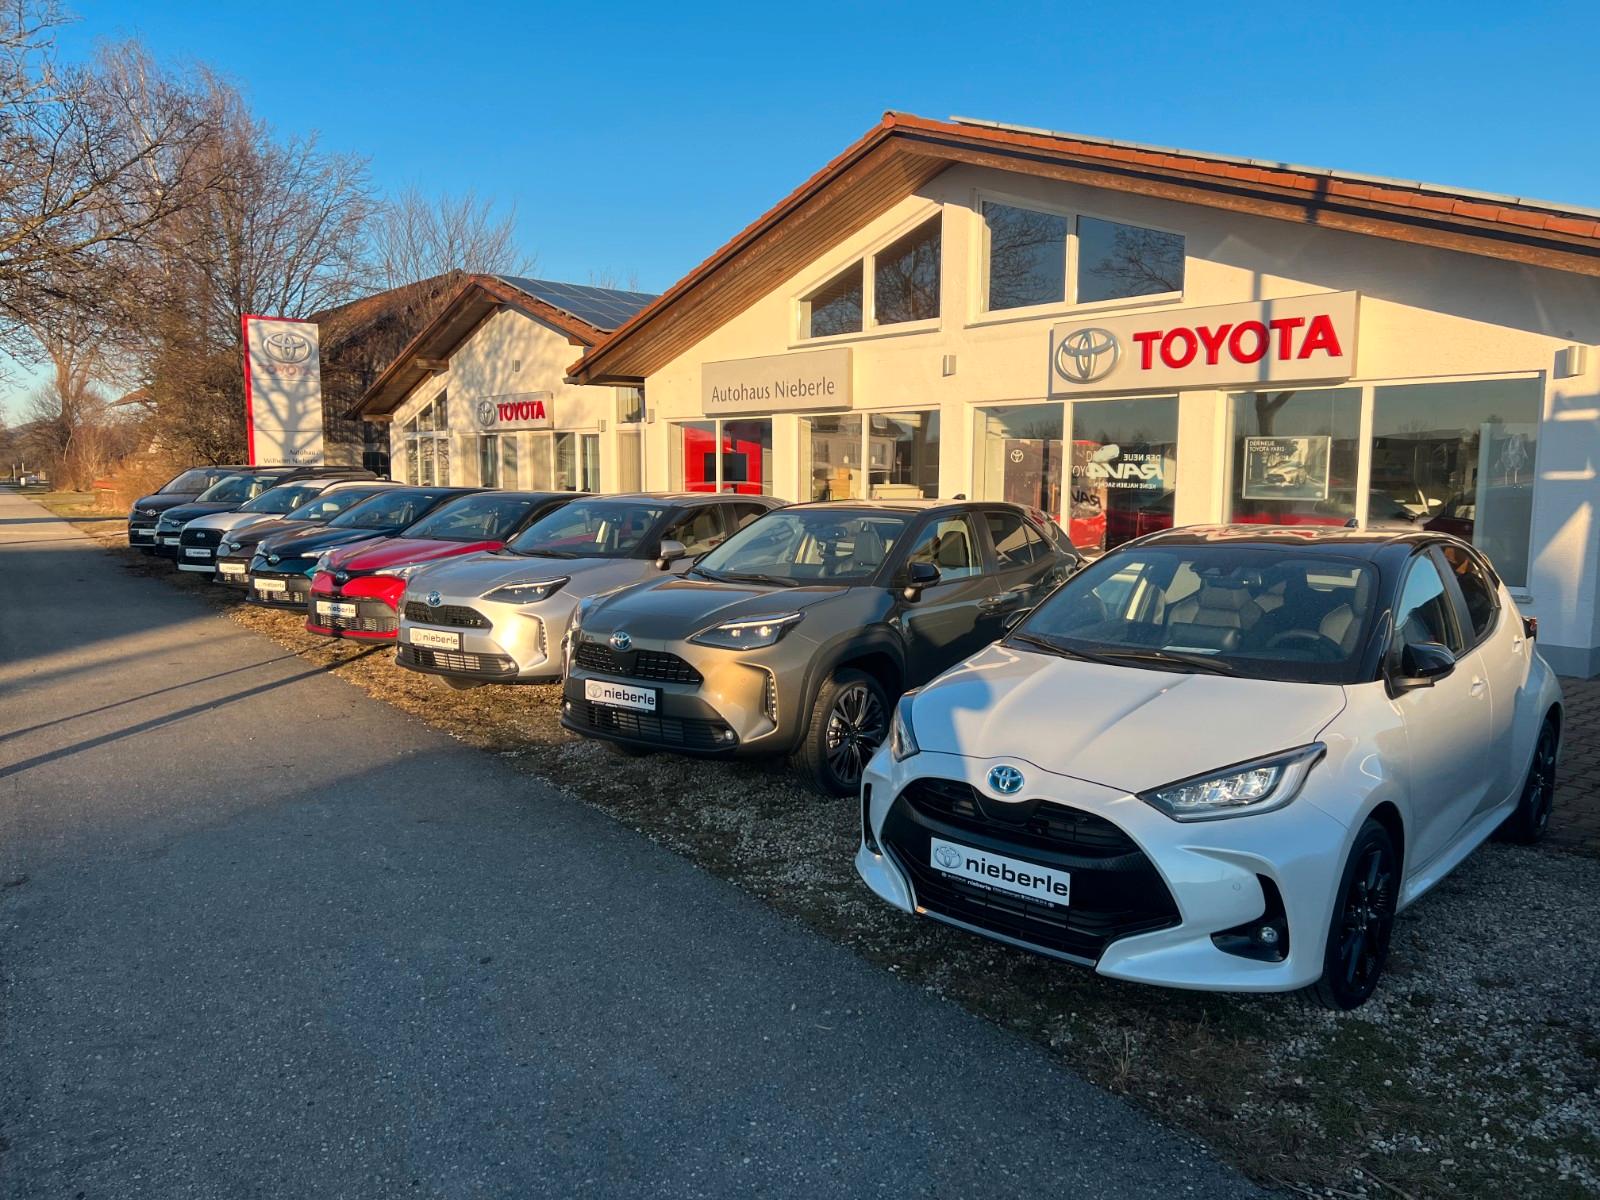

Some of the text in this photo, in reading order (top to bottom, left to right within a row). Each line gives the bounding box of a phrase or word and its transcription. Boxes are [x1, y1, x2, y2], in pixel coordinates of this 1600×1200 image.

[1132, 314, 1343, 370] TOYOTA
[711, 376, 835, 403] Autohaus Nieberle
[496, 400, 546, 422] TOYOTA
[423, 633, 459, 645] nieberle
[604, 688, 655, 706] nieberle
[965, 857, 1068, 897] nieberle
